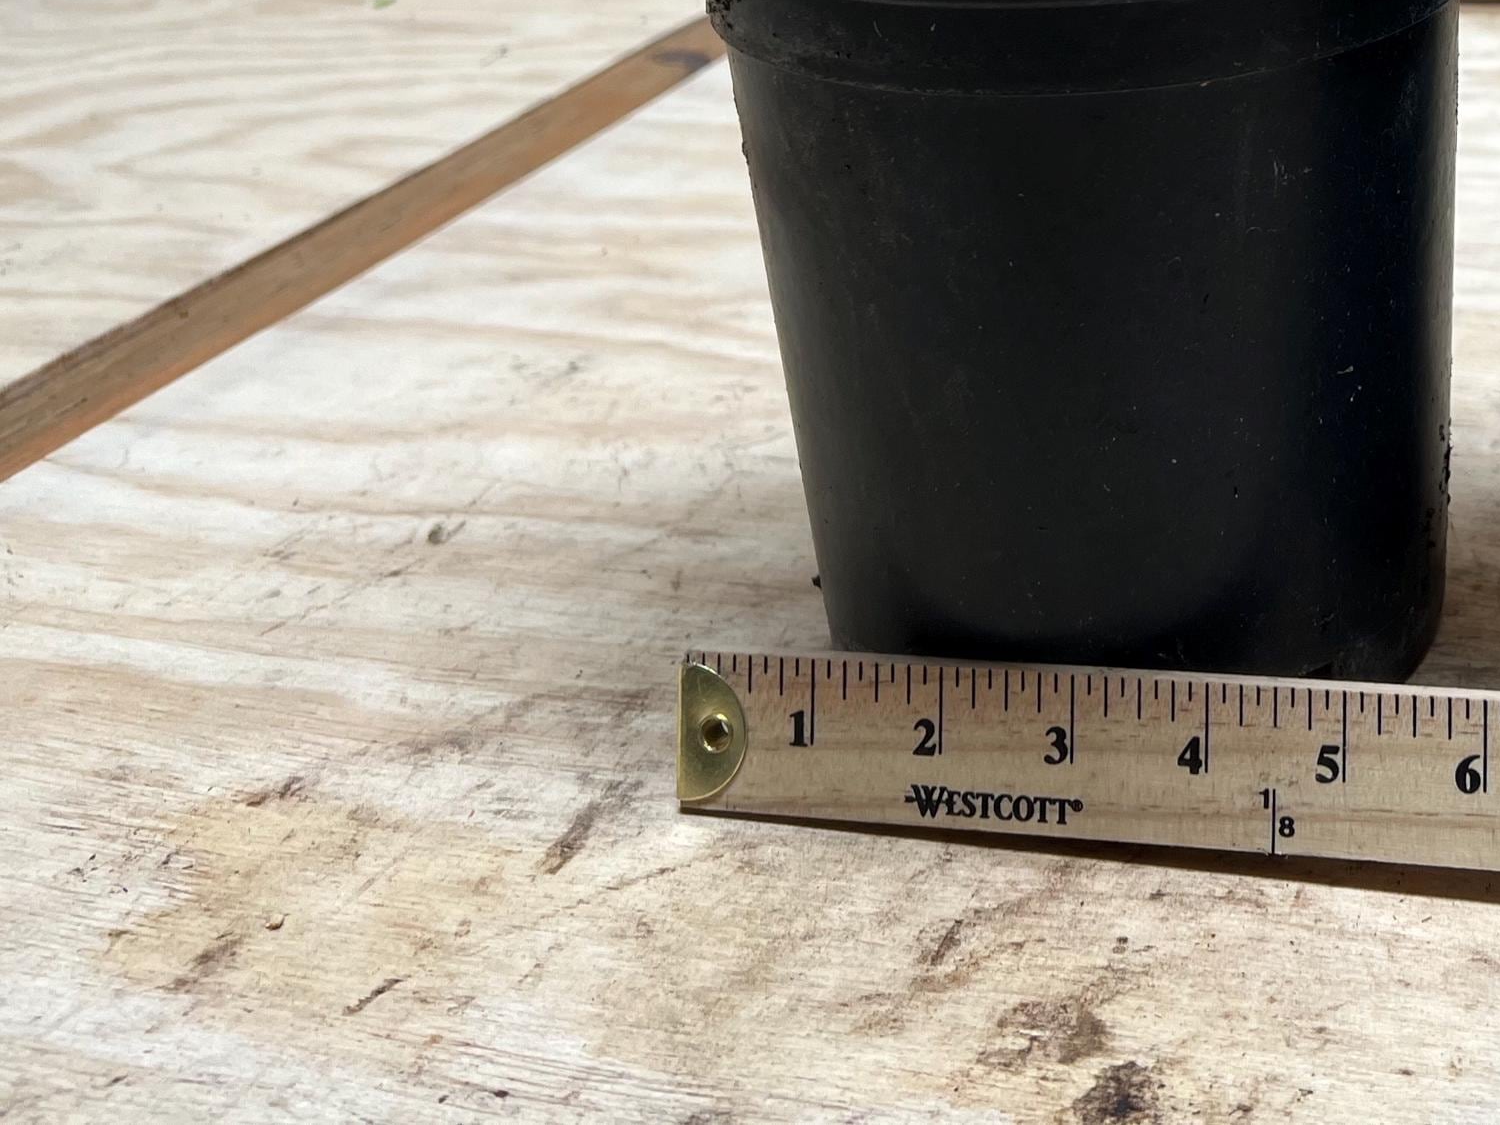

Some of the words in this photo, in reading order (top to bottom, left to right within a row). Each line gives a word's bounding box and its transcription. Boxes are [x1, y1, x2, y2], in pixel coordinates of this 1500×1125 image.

[788, 709, 808, 748] 1
[912, 717, 937, 757] 2
[1043, 726, 1069, 765] 3
[1177, 736, 1203, 775] 4
[1315, 745, 1341, 784] 5
[1454, 754, 1481, 795] 6
